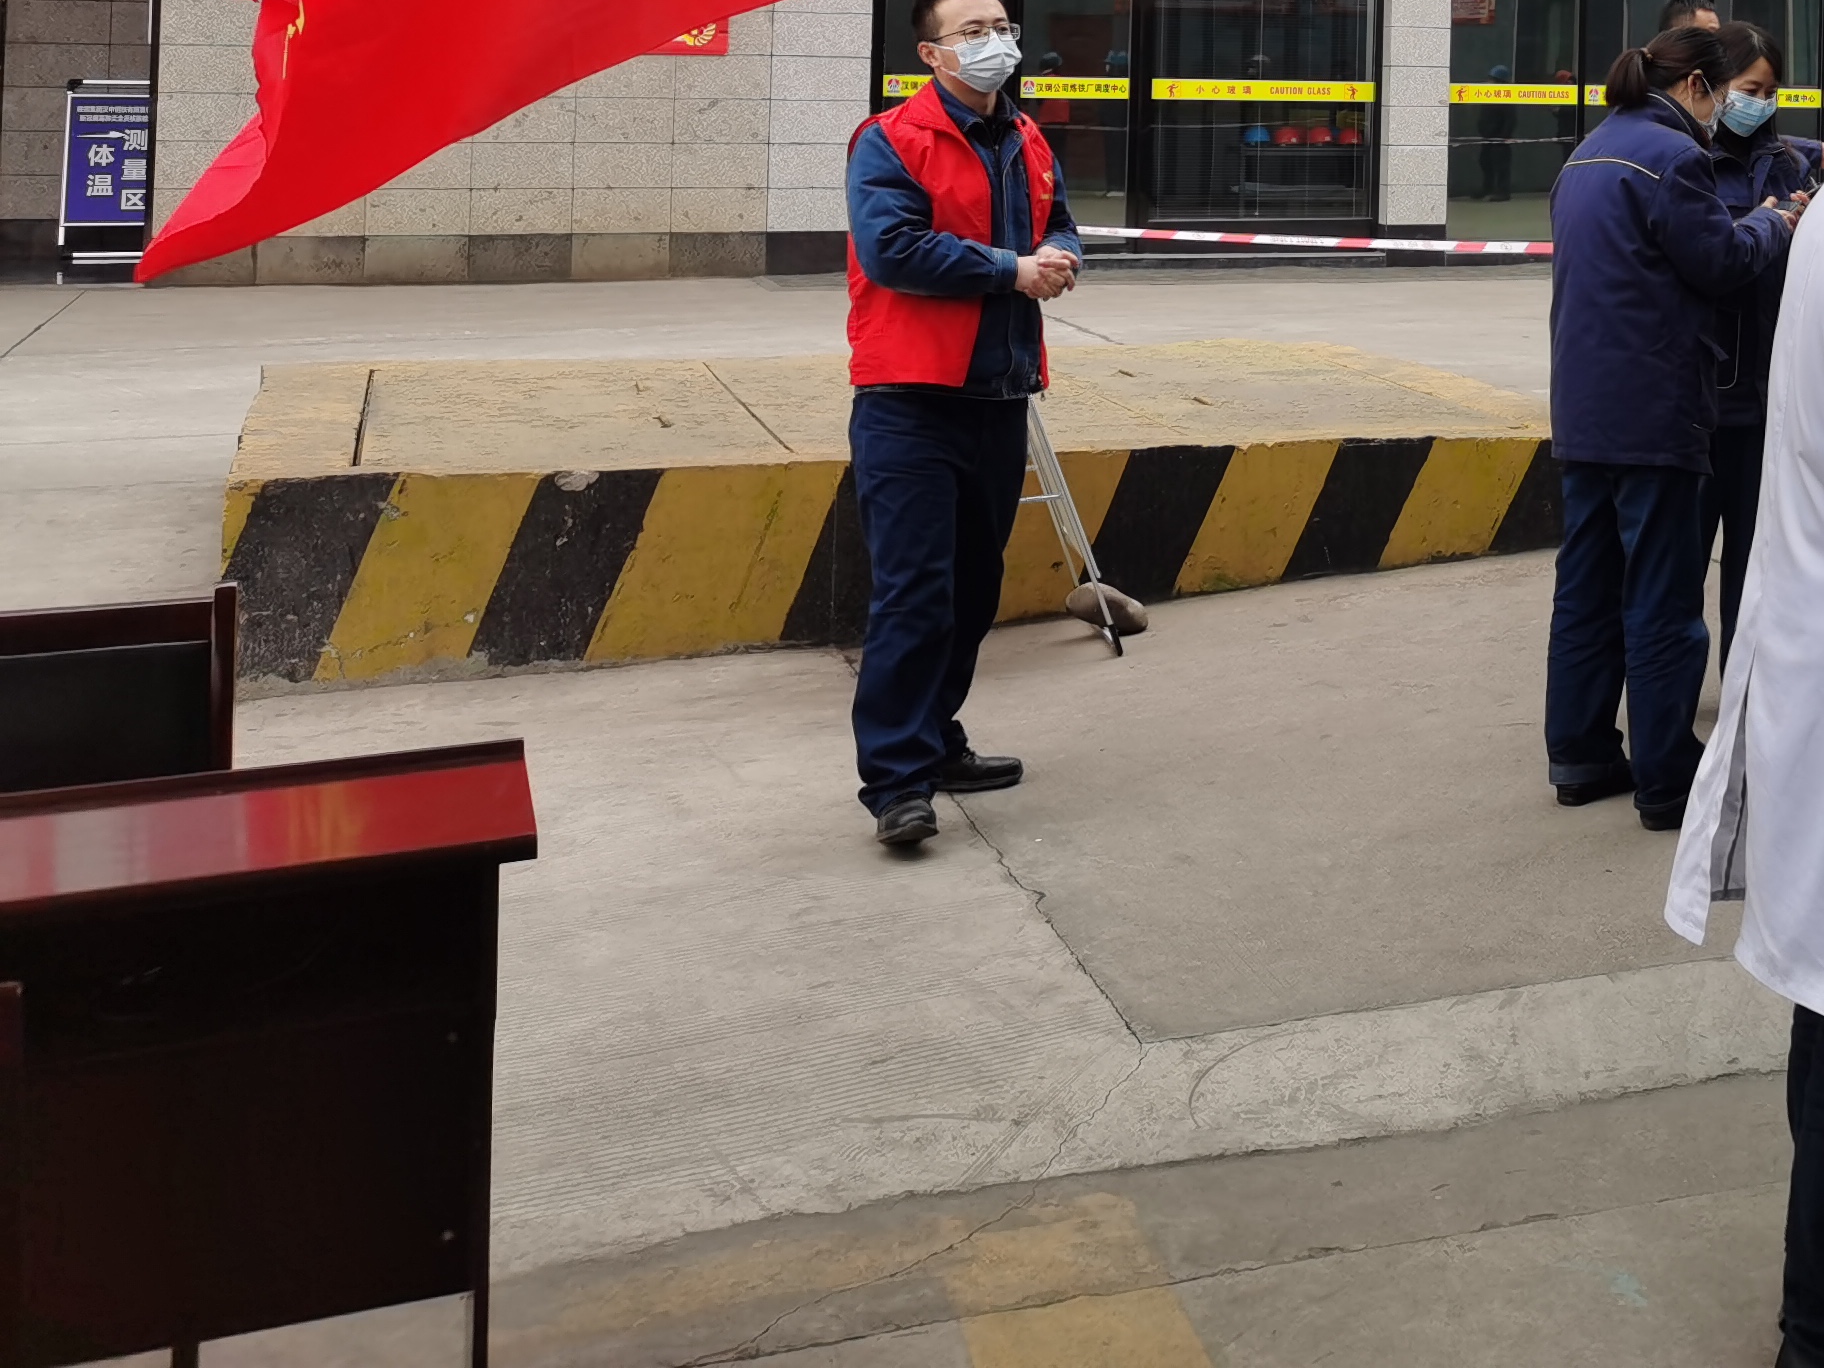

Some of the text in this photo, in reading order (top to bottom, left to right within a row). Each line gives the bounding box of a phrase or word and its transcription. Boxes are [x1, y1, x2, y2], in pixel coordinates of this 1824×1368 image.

[1196, 85, 1331, 96] 小心玻璃 CAUTION GLASS
[1474, 89, 1570, 99] 小心玻璃 CAUTION GLASS
